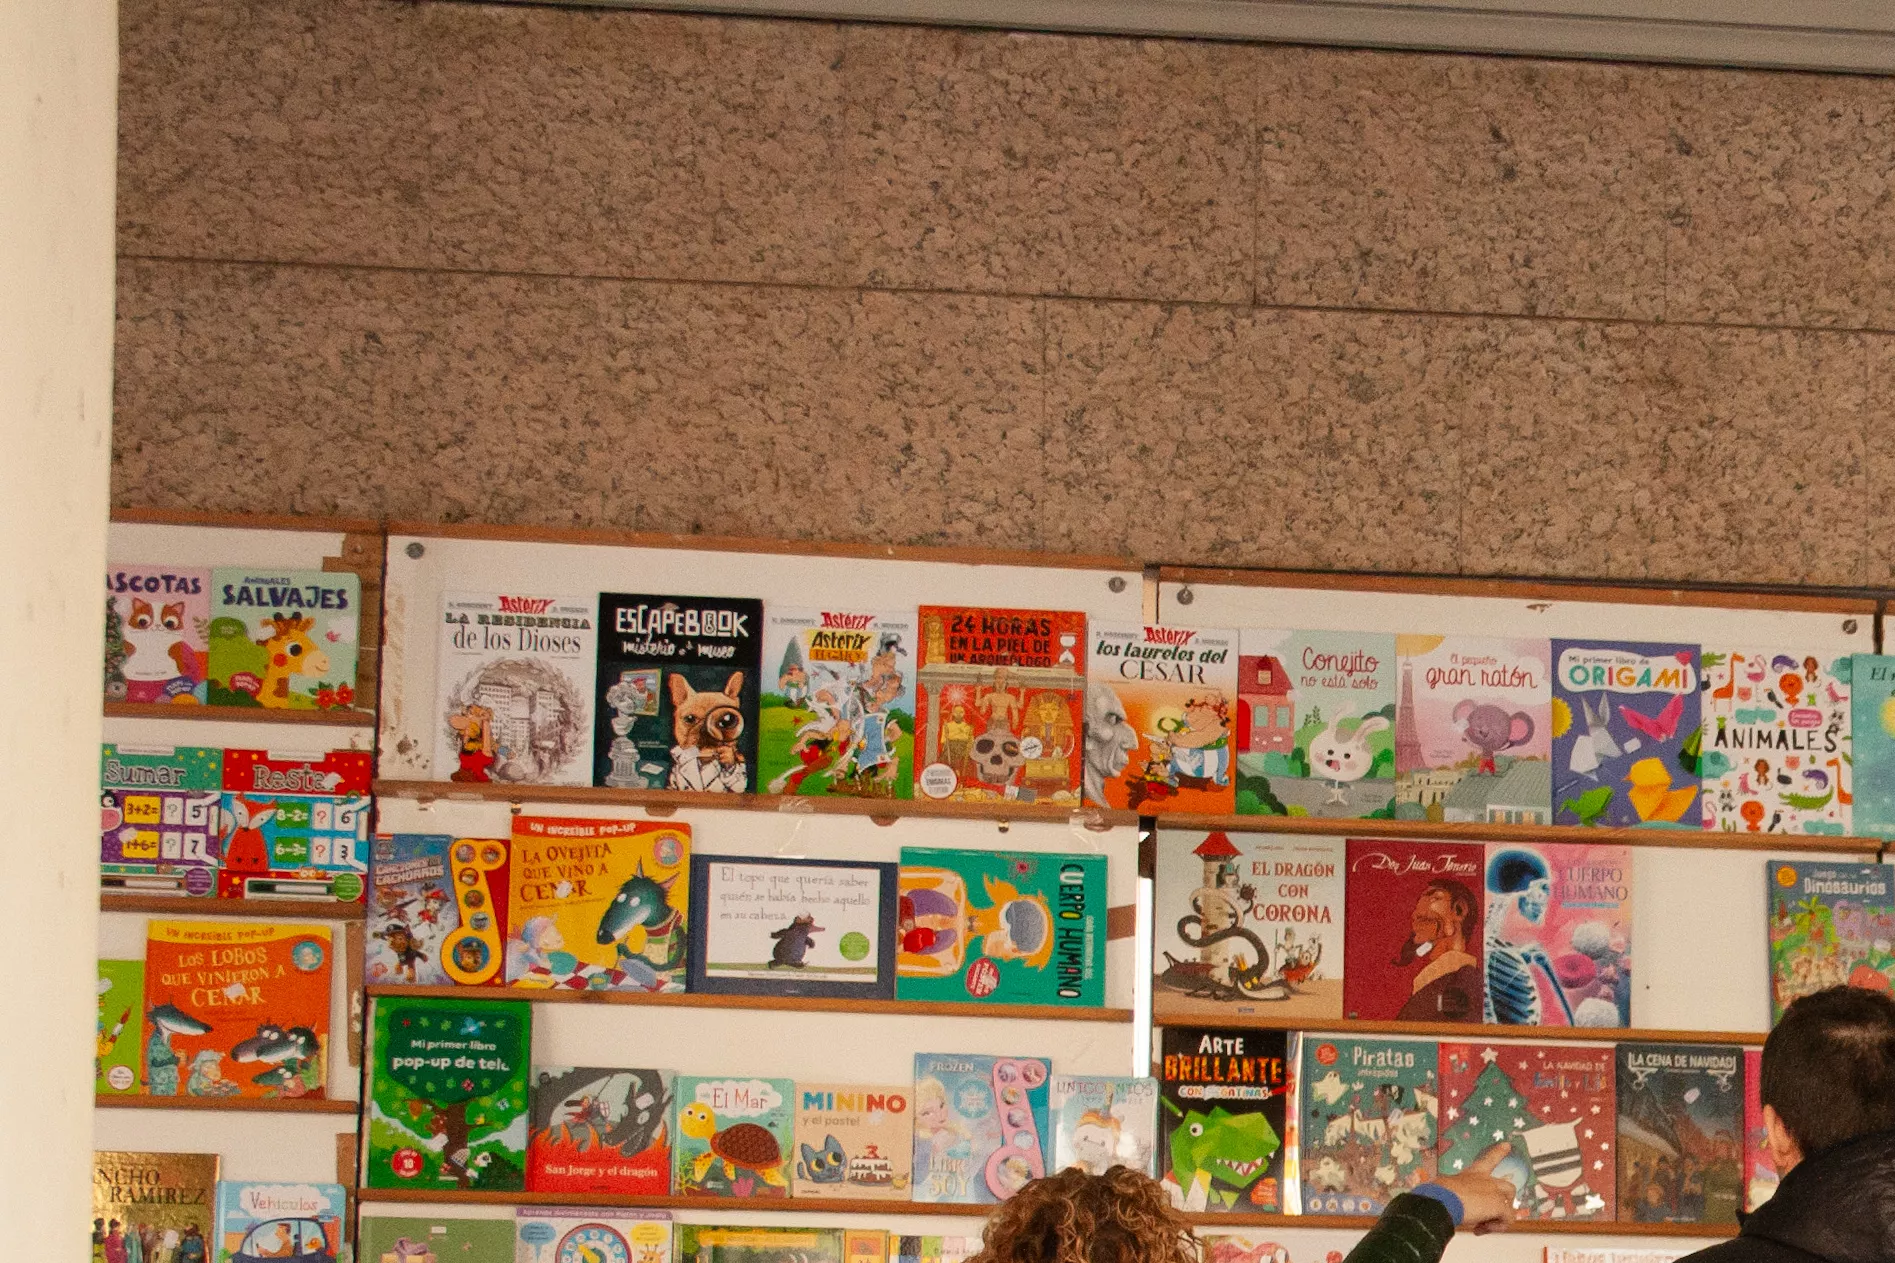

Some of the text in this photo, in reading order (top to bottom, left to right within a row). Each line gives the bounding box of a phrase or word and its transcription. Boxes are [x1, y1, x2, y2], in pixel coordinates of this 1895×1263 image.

[223, 584, 349, 609] SALVAJES
[445, 612, 591, 630] LA RESIDENCIA
[615, 604, 749, 638] ESCAPEBOOK
[951, 615, 1051, 637] 24 HORAS
[453, 625, 581, 652] de los Dioses
[950, 637, 1051, 652] EN LA PIEL DE
[1096, 641, 1228, 664] los laureles del
[1302, 646, 1379, 677] Conejito
[1568, 655, 1650, 666] Mi primer libro de
[1300, 675, 1378, 690] no está solo
[1426, 666, 1537, 690] gran ratón
[1568, 664, 1688, 689] ORIGAMI
[1870, 666, 1887, 681] El
[1714, 724, 1837, 752] ANIMALES
[104, 760, 187, 784] Sumar
[253, 764, 338, 791] Resta
[600, 822, 636, 834] POP-UP
[522, 842, 612, 864] LA OVEJITA
[522, 863, 609, 880] QUE VINO A
[722, 866, 869, 890] El topo que quería saber
[1252, 861, 1335, 877] EL DRAGÓN
[520, 880, 592, 902] CENR
[1059, 864, 1085, 919] CUERPO
[1278, 884, 1308, 898] CON
[1804, 877, 1886, 895] Dinosaurios
[768, 889, 796, 902] había
[833, 893, 870, 911] aquello
[720, 912, 731, 920] en
[1253, 903, 1332, 924] CORONA
[178, 947, 267, 968] LOS LOBOS
[1057, 927, 1083, 999] HUMANO
[162, 964, 286, 986] QUE VINIERON A
[410, 1039, 497, 1051] Mi primer libro
[1199, 1035, 1244, 1055] ARTE
[392, 1056, 450, 1071] pop-up
[454, 1056, 475, 1069] de
[930, 1061, 974, 1073] FROZEN
[1353, 1047, 1415, 1068] Piratas
[1632, 1054, 1734, 1069] LA CENA DE NAVIDAD
[1164, 1054, 1282, 1084] BRILLANTE
[712, 1087, 768, 1110] El Mar
[802, 1091, 906, 1114] MININO
[824, 1116, 860, 1130] pastel
[545, 1165, 565, 1175] San
[567, 1166, 595, 1178] Jorge
[608, 1165, 617, 1176] el
[619, 1165, 658, 1179] dragón
